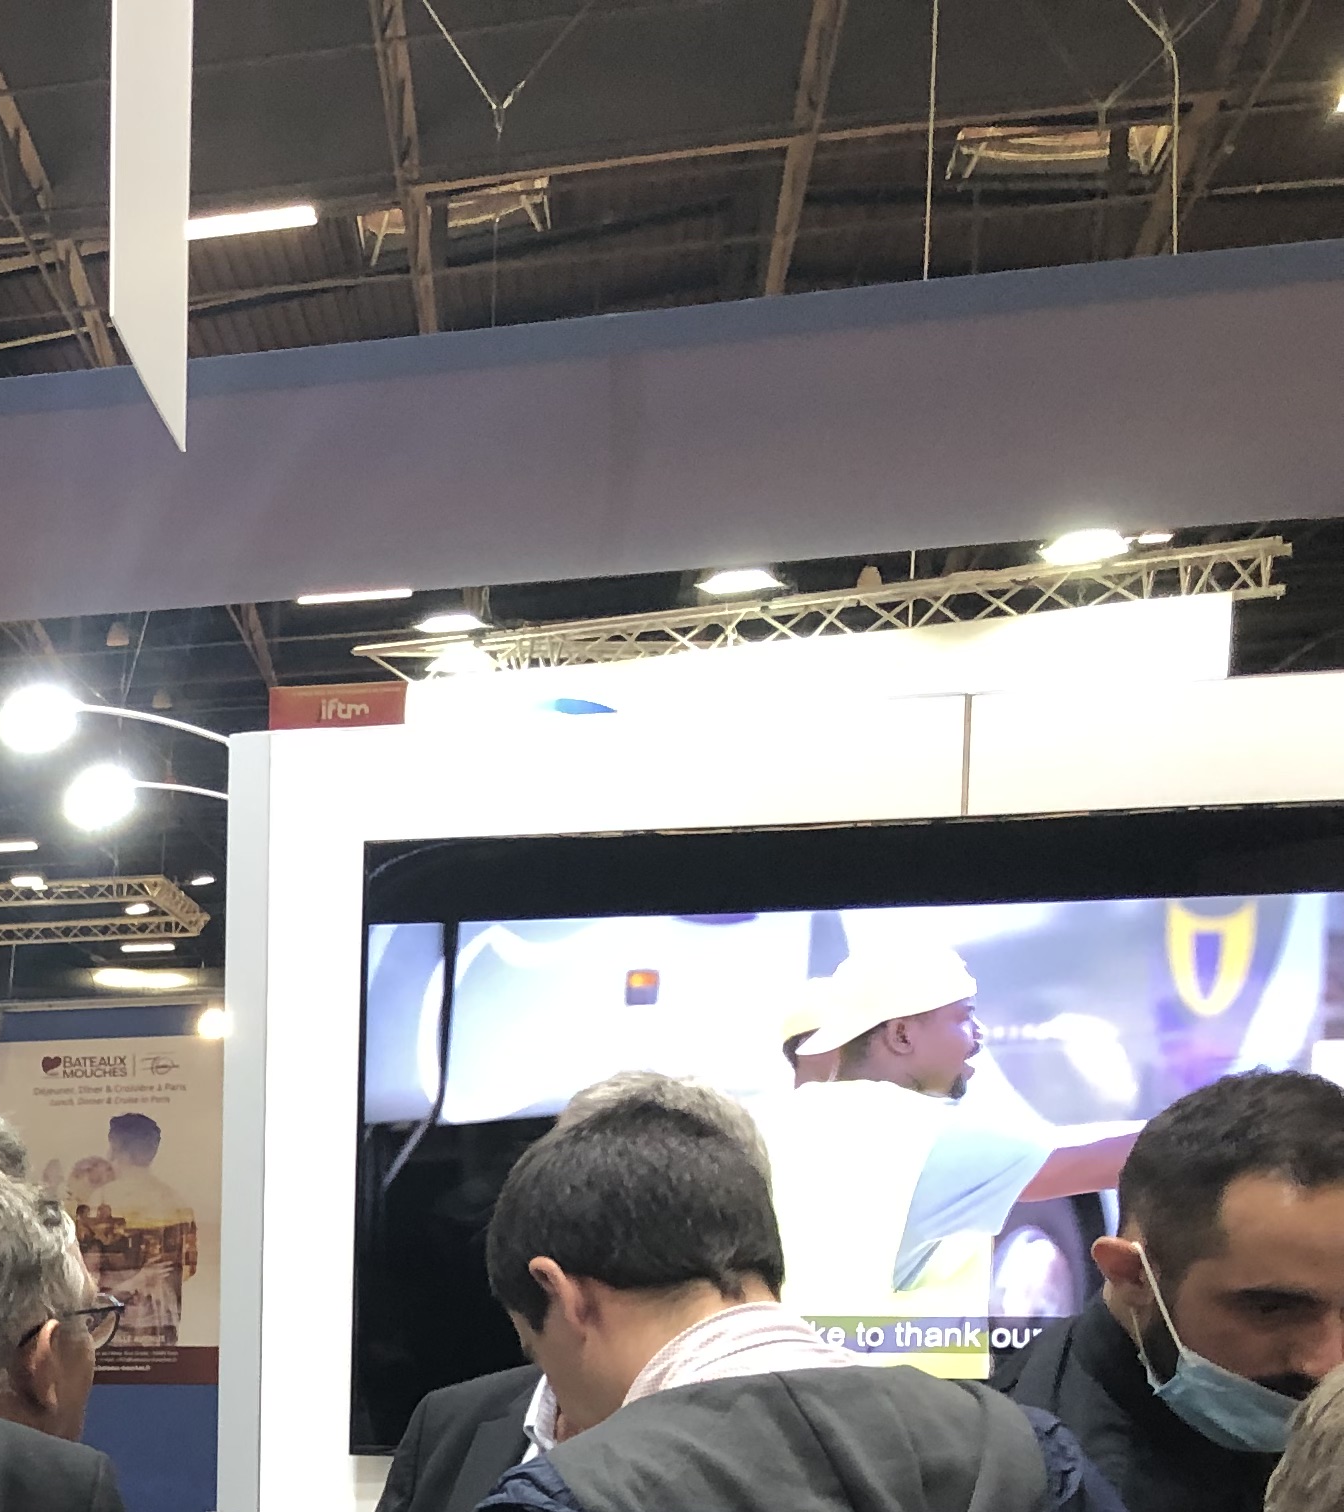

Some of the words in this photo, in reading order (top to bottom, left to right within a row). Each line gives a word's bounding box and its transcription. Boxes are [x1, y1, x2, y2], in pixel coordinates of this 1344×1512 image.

[320, 698, 370, 720] iftm
[63, 1055, 127, 1068] BATEAUX
[63, 1067, 128, 1079] MOUCHES
[855, 1321, 885, 1348] to
[895, 1320, 982, 1348] thank
